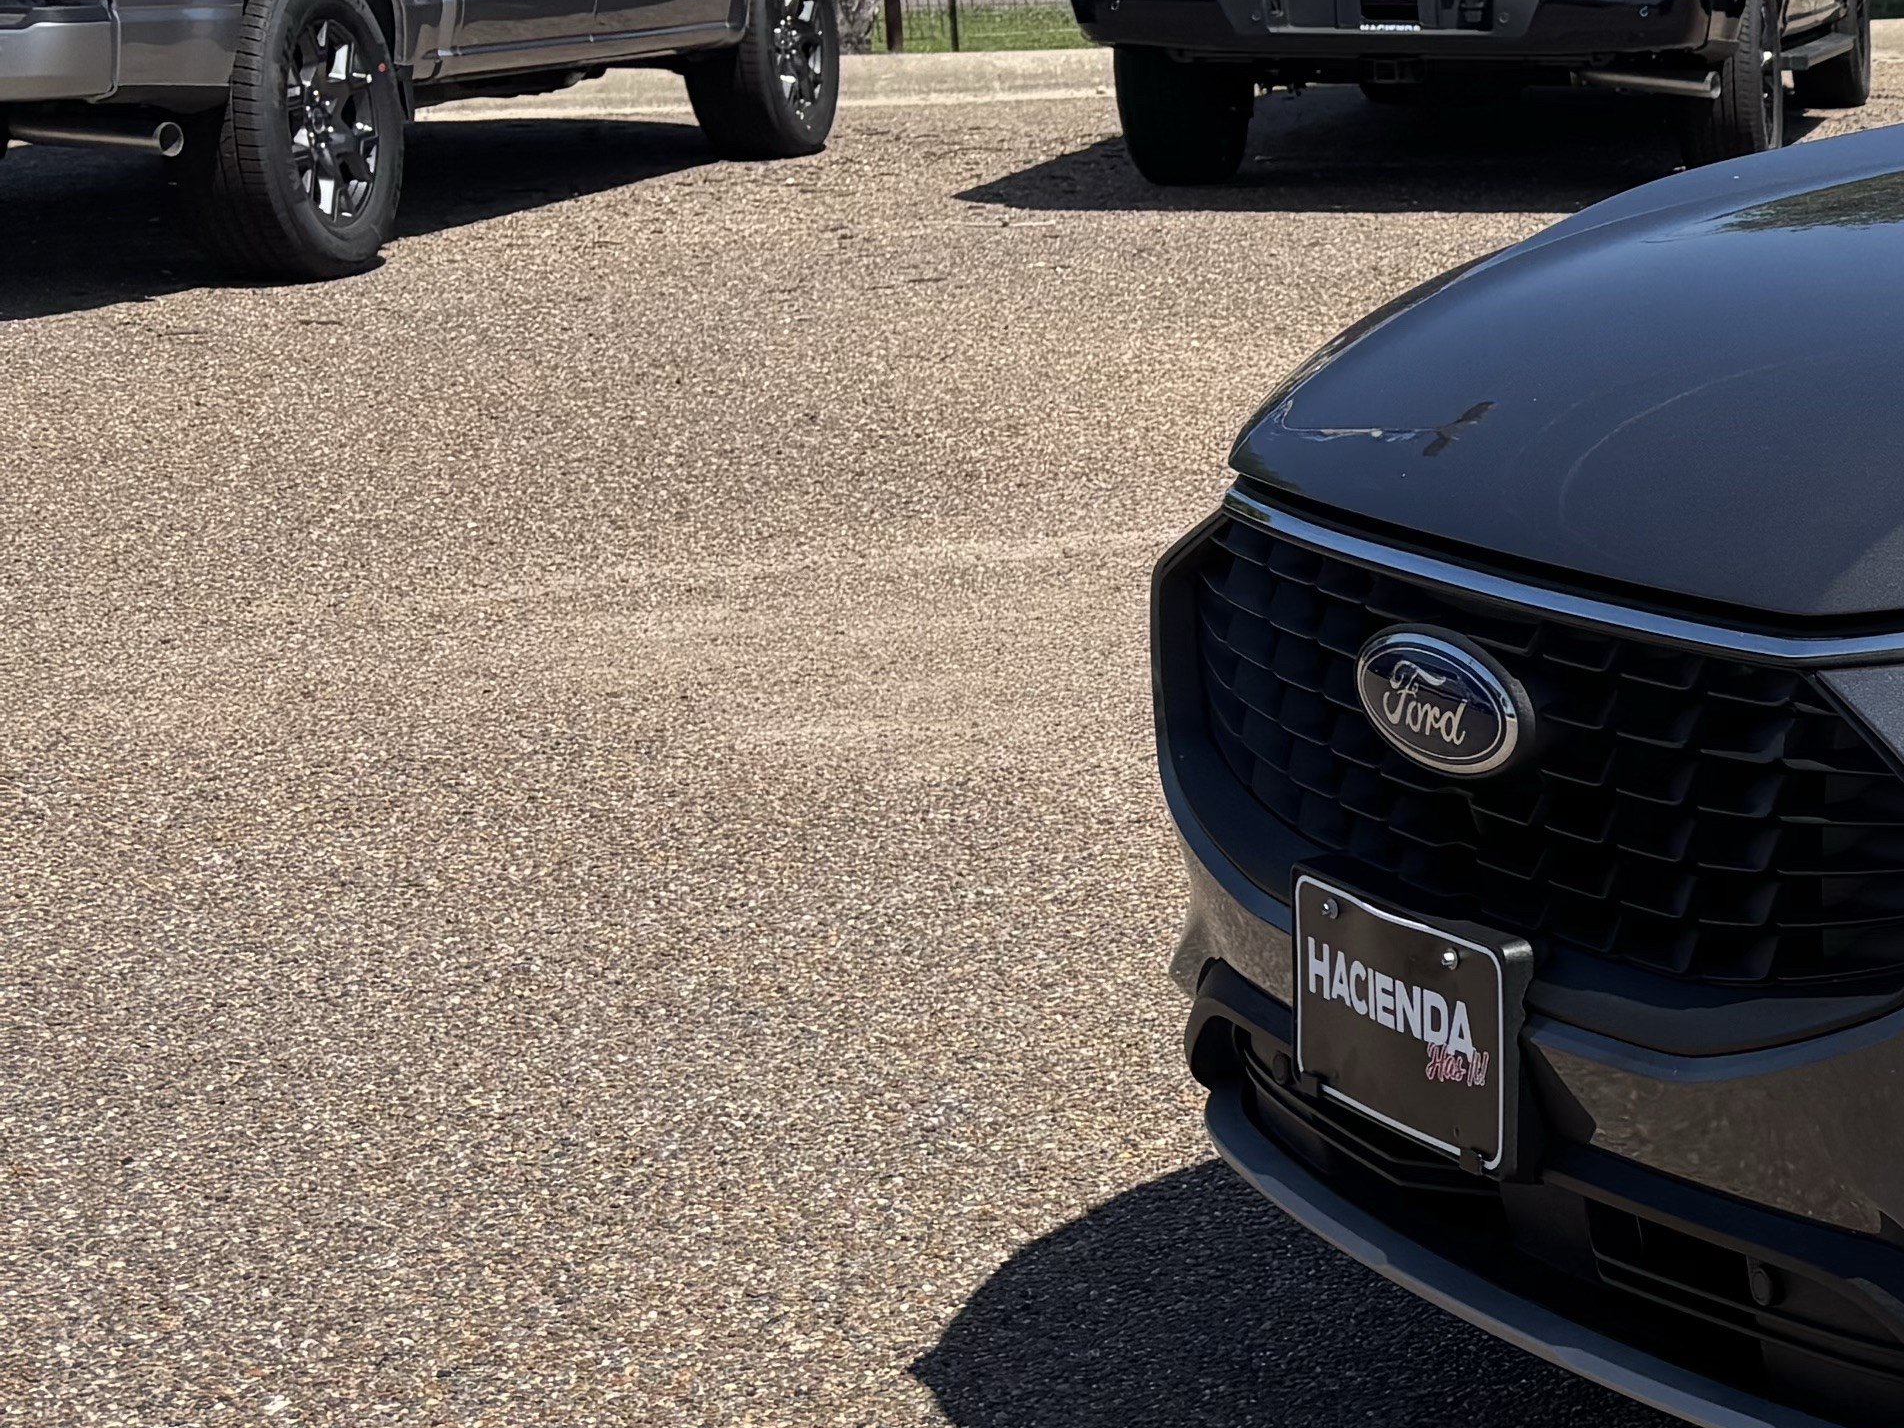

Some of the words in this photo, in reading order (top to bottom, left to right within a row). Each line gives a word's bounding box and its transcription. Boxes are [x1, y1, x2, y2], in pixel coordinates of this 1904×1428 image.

[1382, 659, 1468, 746] Ford
[1307, 936, 1474, 1062] HACIENDA
[1425, 1041, 1467, 1083] Has
